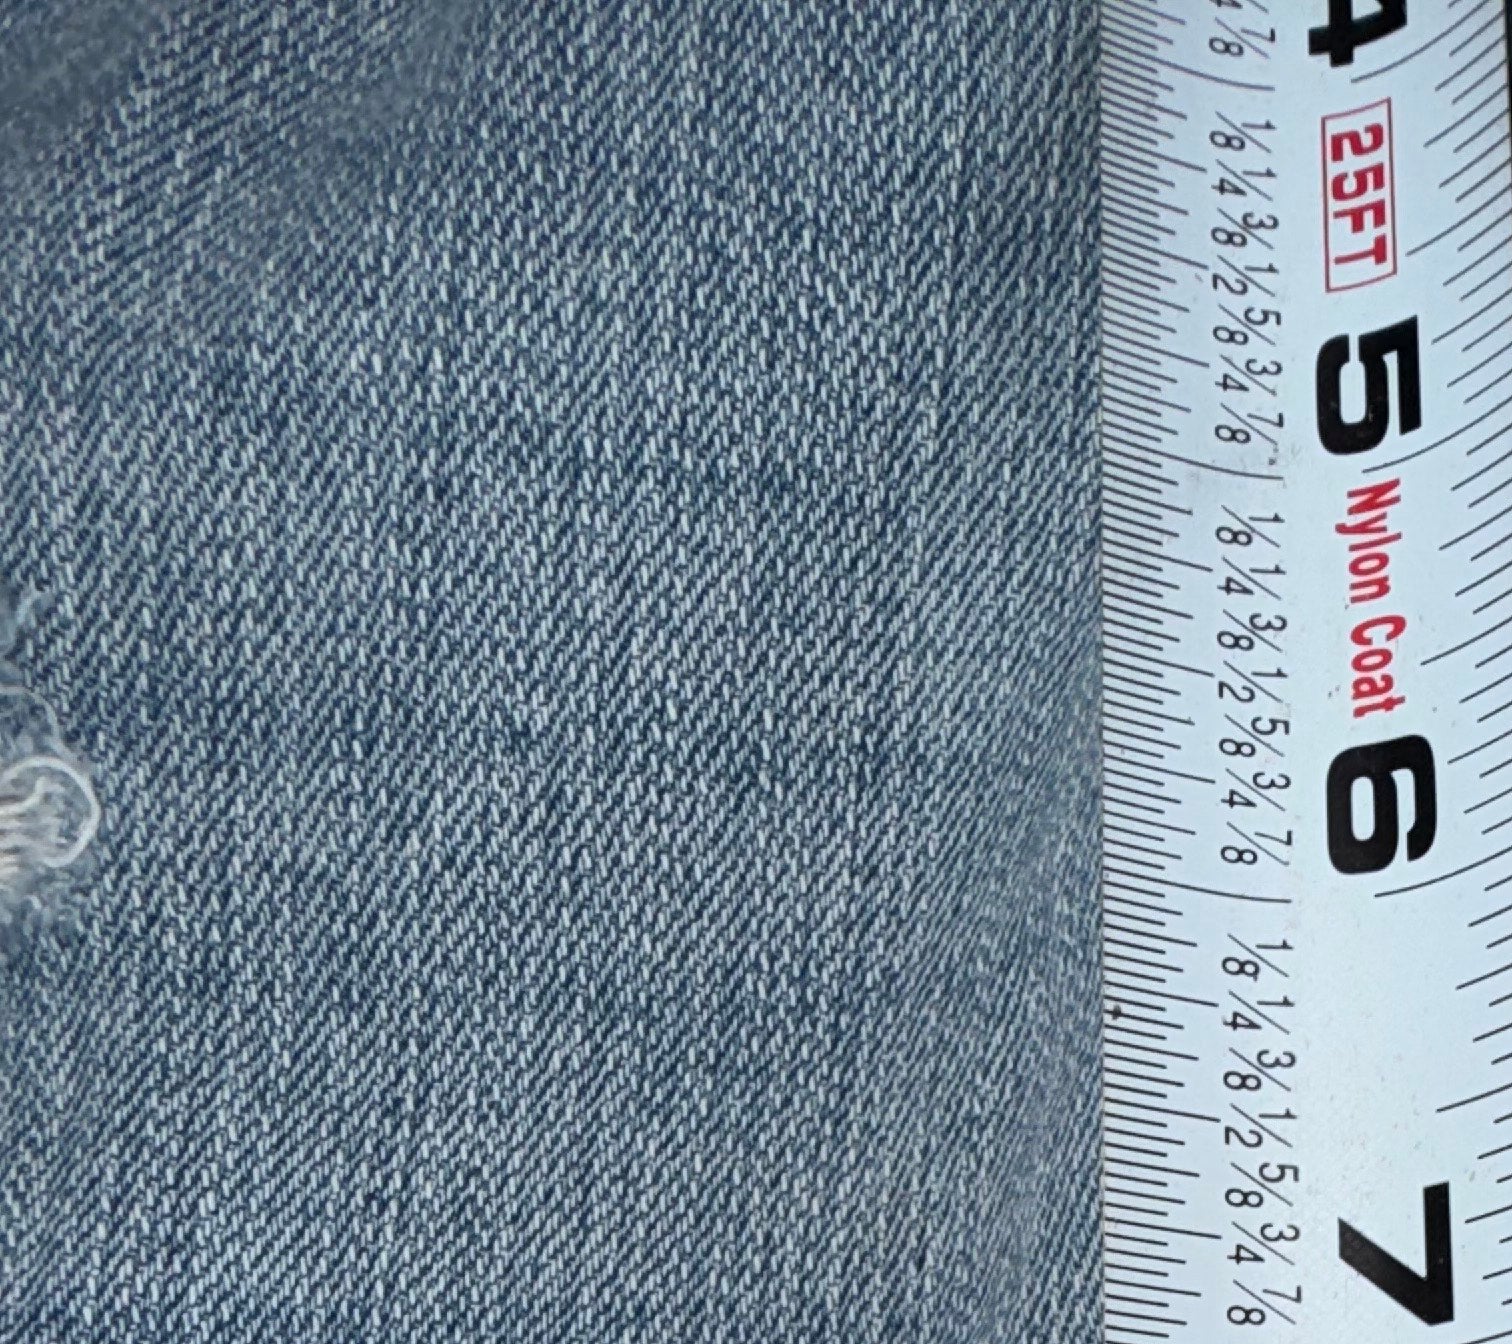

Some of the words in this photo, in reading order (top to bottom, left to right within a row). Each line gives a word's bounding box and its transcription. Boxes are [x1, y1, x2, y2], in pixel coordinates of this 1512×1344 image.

[1208, 110, 1278, 154] 1/8
[1210, 158, 1278, 202] 1/4
[1330, 122, 1387, 267] 25FT
[1210, 207, 1280, 250] 3/8
[1211, 254, 1281, 298] 1/2
[1212, 303, 1283, 346] 5/8
[1214, 354, 1284, 398] 3/4
[1315, 315, 1422, 455] 5
[1214, 402, 1286, 448] 7/8
[1214, 504, 1286, 549] 1/8
[1336, 478, 1403, 605] Nylon
[1216, 555, 1288, 601] 1/4
[1216, 608, 1289, 654] 3/8
[1216, 660, 1290, 704] 1/2
[1349, 615, 1407, 719] Coat
[1217, 713, 1292, 758] 5/8
[1220, 767, 1292, 813] 3/4
[1326, 734, 1438, 875] 6
[1219, 820, 1294, 868] 7/8
[1220, 932, 1296, 980] 1/8
[1222, 990, 1297, 1036] 1/4
[1222, 1046, 1298, 1093] 3/8
[1223, 1102, 1300, 1149] 1/2
[1224, 1161, 1300, 1209] 5/8
[1226, 1220, 1302, 1266] 3/4
[1337, 1181, 1454, 1327] 7
[1226, 1278, 1304, 1327] 7/8
